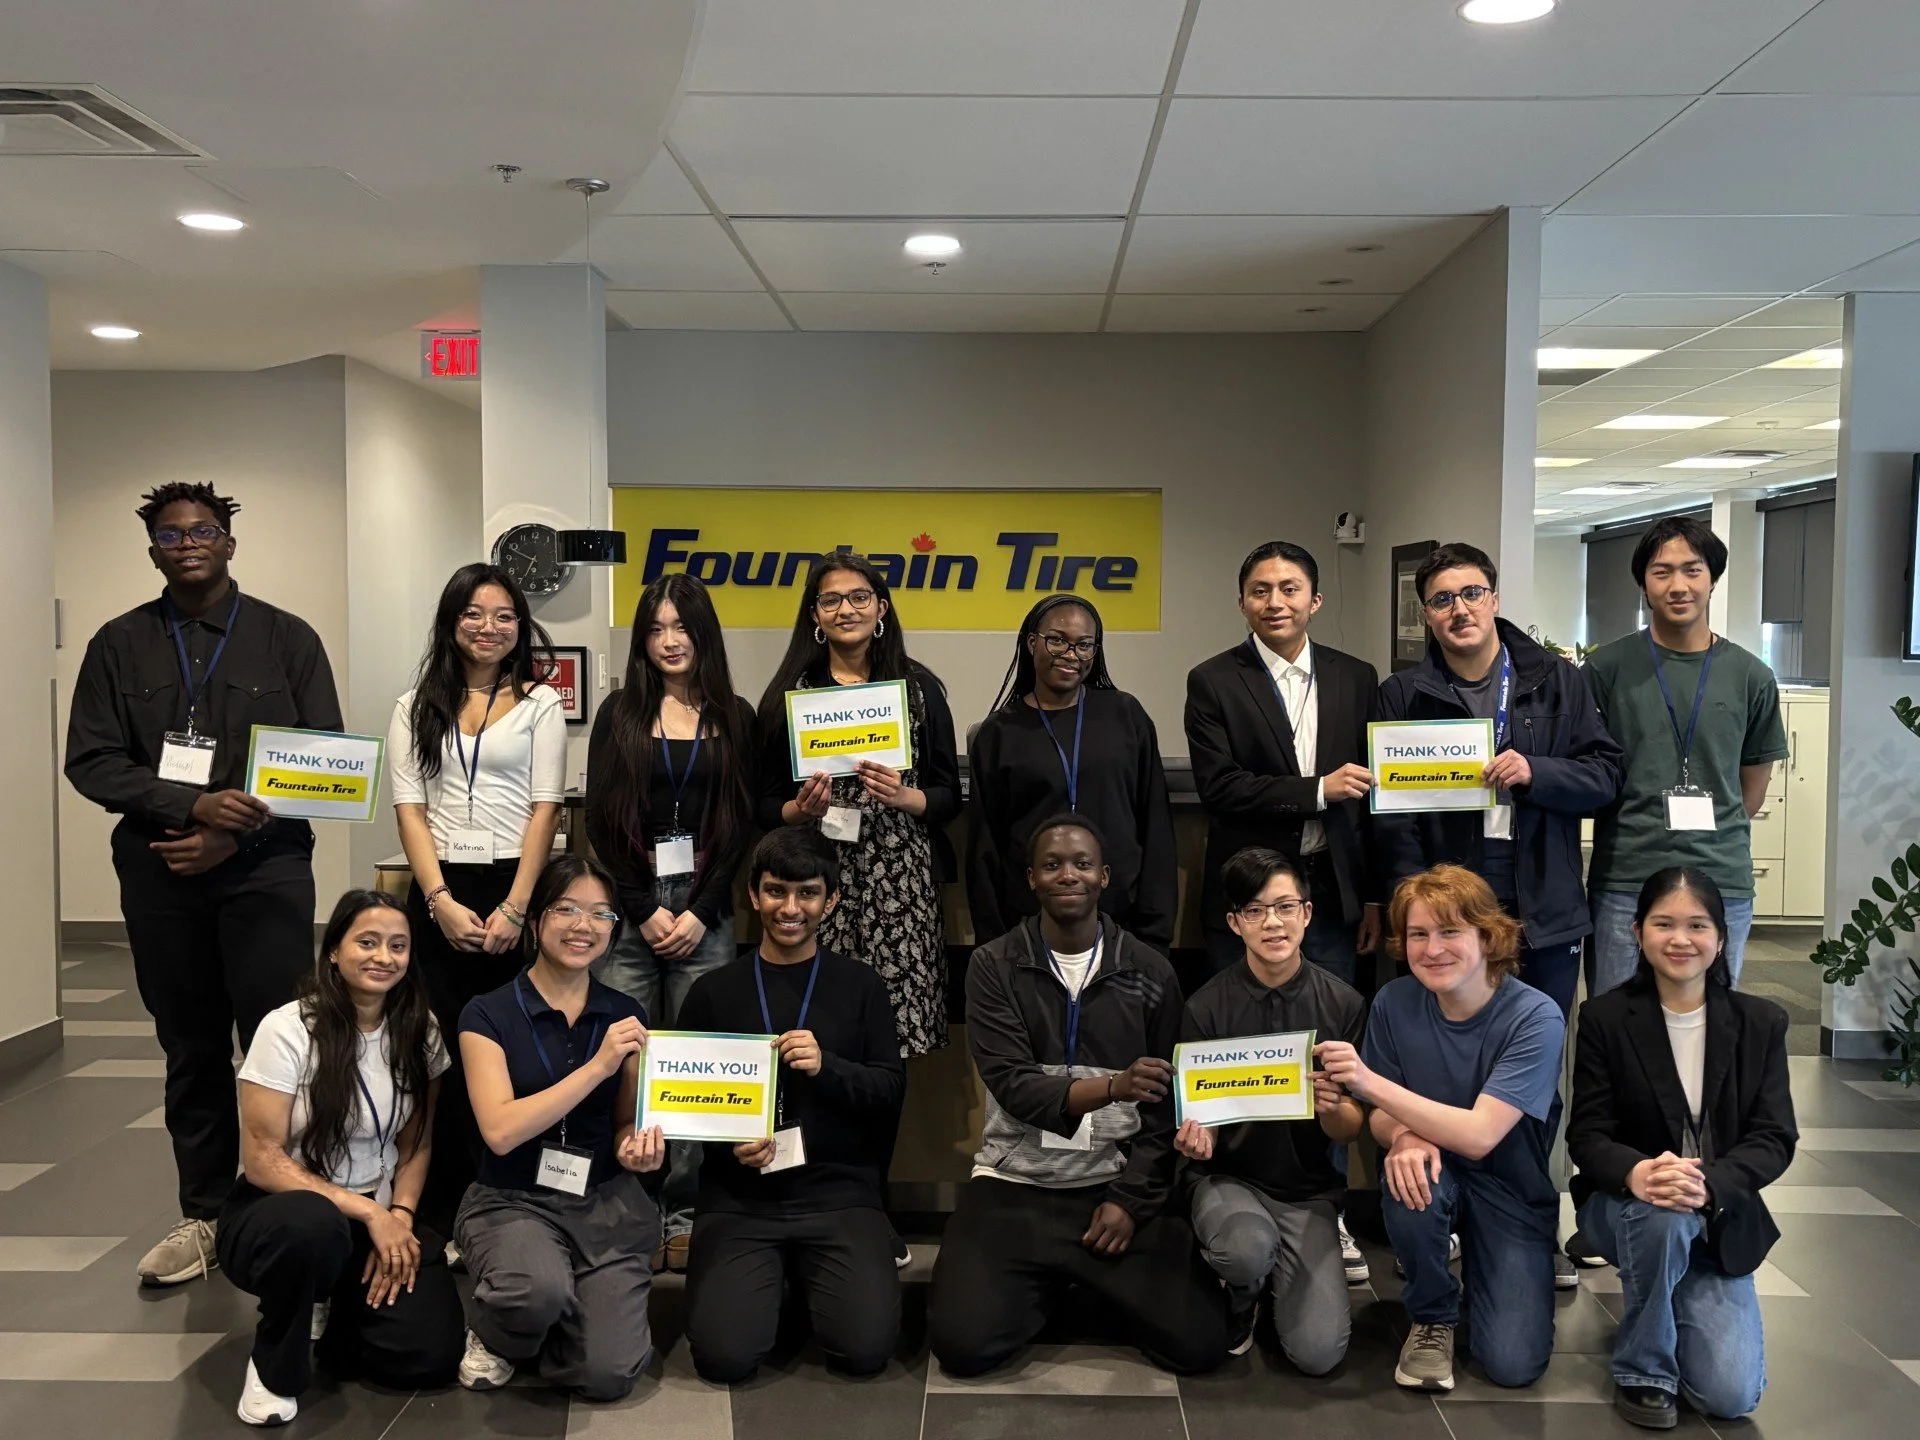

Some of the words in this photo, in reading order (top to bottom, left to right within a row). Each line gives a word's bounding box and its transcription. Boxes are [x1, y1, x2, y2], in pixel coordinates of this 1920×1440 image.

[432, 337, 479, 376] EXIT
[531, 531, 539, 539] 12
[505, 554, 512, 562] 9
[641, 528, 978, 590] Founain
[997, 532, 1138, 591] Tire
[508, 567, 515, 575] 8
[803, 710, 854, 724] THANK
[857, 706, 891, 719] YOU!
[809, 736, 865, 749] Fountain
[867, 733, 890, 743] Tire
[1384, 746, 1437, 757] THANK
[1441, 745, 1477, 756] YOU!
[266, 750, 322, 767] THANK
[327, 758, 364, 771] YOU!
[1388, 772, 1447, 782] Fountain
[1450, 771, 1474, 781] Tire
[266, 777, 329, 793] Fountain
[332, 784, 357, 794] Tire
[453, 842, 485, 851] Katrina
[1191, 1051, 1249, 1064] THANK
[1254, 1048, 1293, 1060] YOU!
[657, 1061, 715, 1073] THANK
[720, 1063, 758, 1075] YOU!
[1195, 1077, 1259, 1091] Fountain
[1262, 1075, 1289, 1086] Tire
[660, 1091, 723, 1104] Fountain
[726, 1093, 752, 1105] Tire
